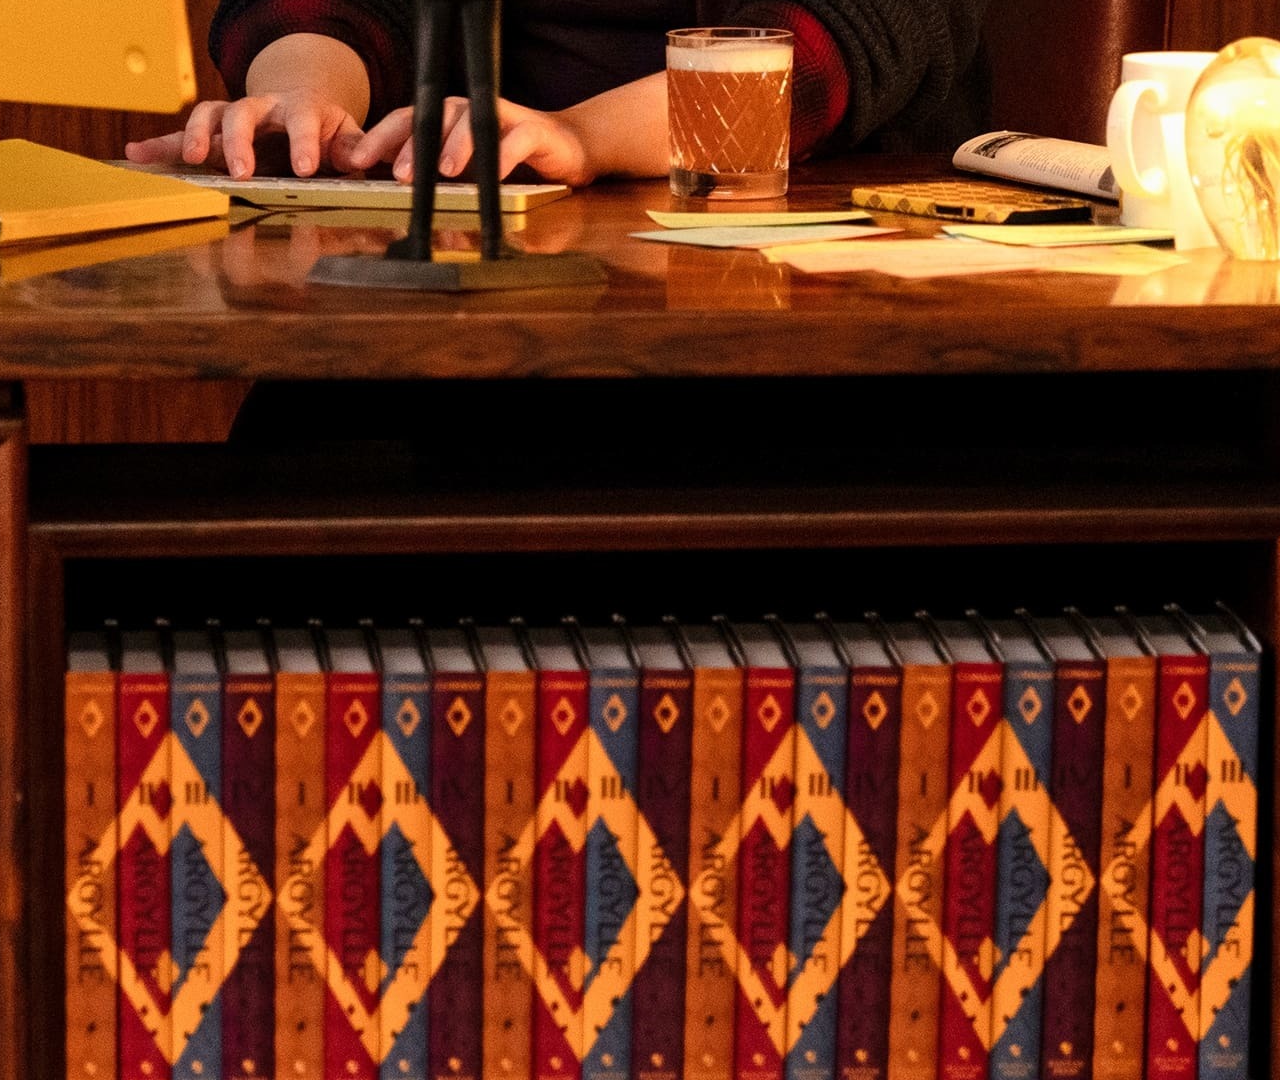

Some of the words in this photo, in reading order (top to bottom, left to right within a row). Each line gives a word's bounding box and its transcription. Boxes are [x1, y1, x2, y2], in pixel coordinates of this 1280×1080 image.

[77, 835, 103, 983] ARGYLLE
[184, 835, 210, 982] ARGYLLE
[238, 834, 263, 981] RGYL
[289, 832, 315, 984] ARGYLLE
[394, 834, 419, 980] ARGYLLE
[445, 832, 470, 979] RGYL
[496, 831, 522, 981] ARGYLLE
[598, 832, 623, 976] ARGYLLE
[650, 830, 676, 975] RGYL
[699, 829, 724, 978] ARGYLLE
[803, 830, 828, 973] ARGYLLE
[856, 827, 881, 972] RGYL
[905, 823, 932, 972] ARGYLLE
[1009, 825, 1036, 967] ARGYLLE
[1060, 822, 1087, 966] RGYL
[1110, 818, 1138, 966] ARGYLLE
[1216, 818, 1245, 959] ARGYLLE
